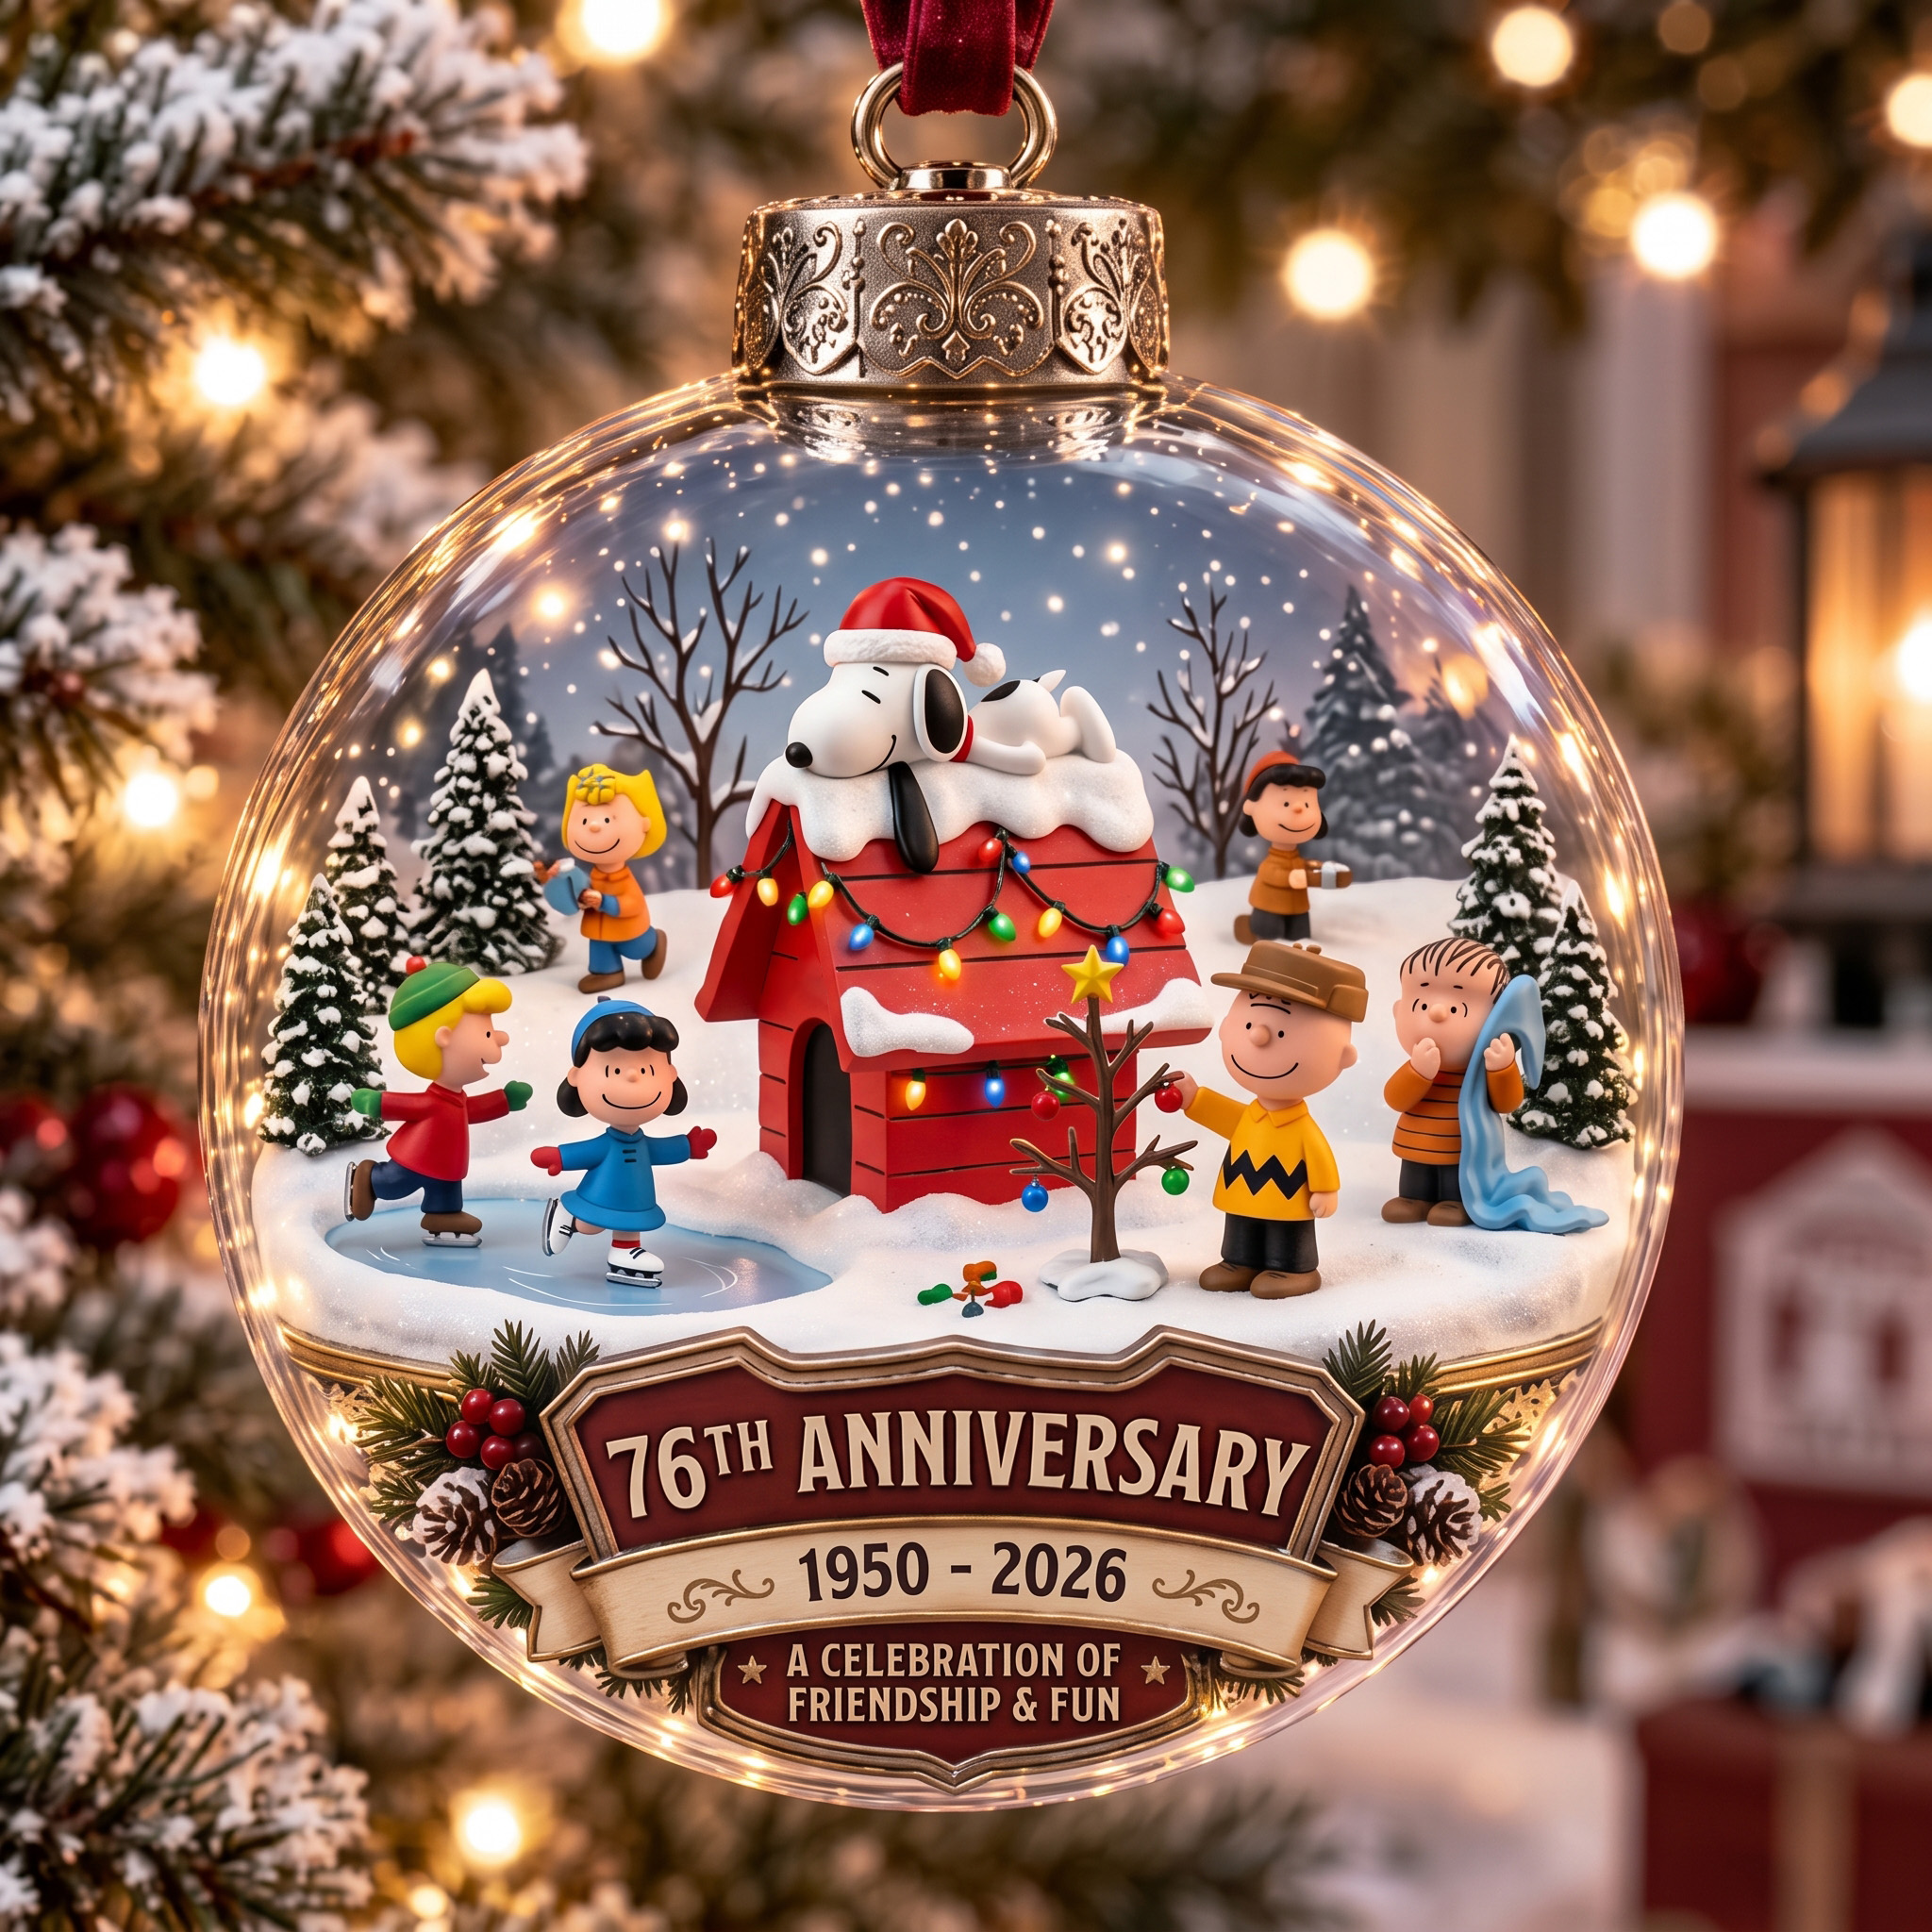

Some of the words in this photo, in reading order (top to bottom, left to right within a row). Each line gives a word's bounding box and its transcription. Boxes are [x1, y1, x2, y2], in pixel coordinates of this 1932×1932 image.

[606, 1419, 774, 1519] 76TH
[797, 1409, 1311, 1517] ANNIVERSARY
[798, 1541, 929, 1603] 1950
[991, 1541, 1127, 1603] 2026
[786, 1643, 809, 1677] A
[821, 1642, 1064, 1677] CELEBRATION
[1076, 1642, 1121, 1677] OF
[789, 1687, 1001, 1723] FRIENDSHIP
[1012, 1686, 1038, 1722] &
[1050, 1687, 1120, 1723] FUN
